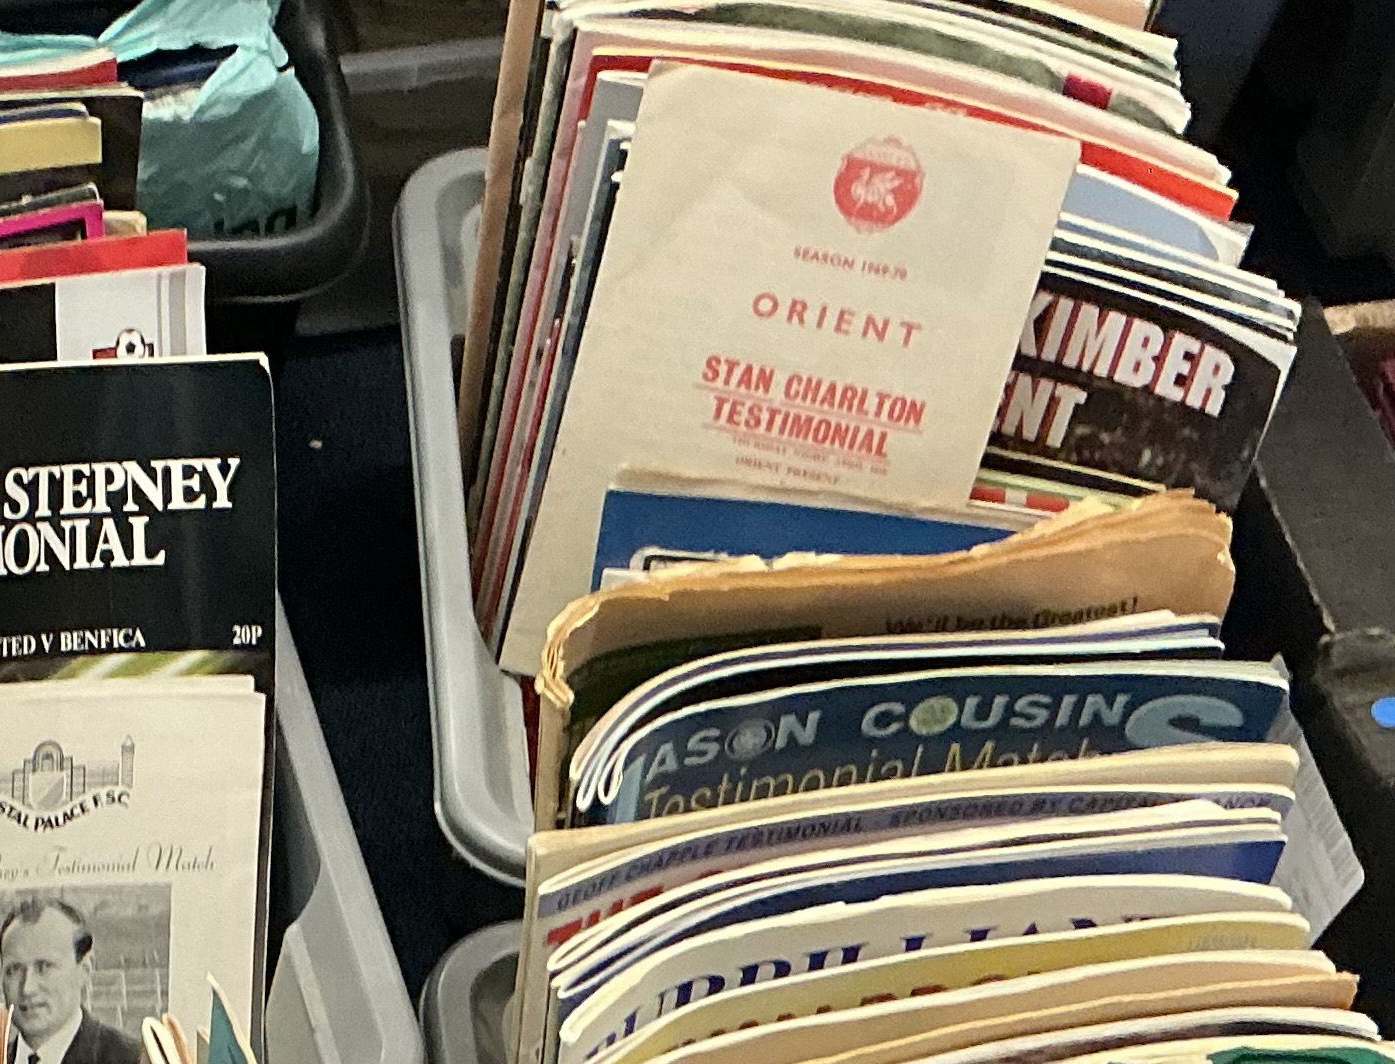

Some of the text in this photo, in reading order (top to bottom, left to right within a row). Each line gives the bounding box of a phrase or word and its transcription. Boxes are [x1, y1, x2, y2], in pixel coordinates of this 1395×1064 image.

[793, 245, 855, 270] SEASON
[752, 291, 922, 348] ORIENT
[1019, 290, 1235, 418] KIMBER
[702, 355, 926, 427] STAN CHARLTON
[992, 371, 1088, 449] NT
[711, 396, 889, 458] TESTIMONIAL
[3, 456, 241, 520] STEPNEY
[41, 633, 55, 654] V
[60, 626, 147, 653] BENFICA
[232, 624, 263, 646] 20P
[33, 801, 90, 832] PALACE
[726, 817, 862, 851] TESTIMONIAL
[36, 845, 140, 873] Testimonial
[146, 841, 218, 872] Match
